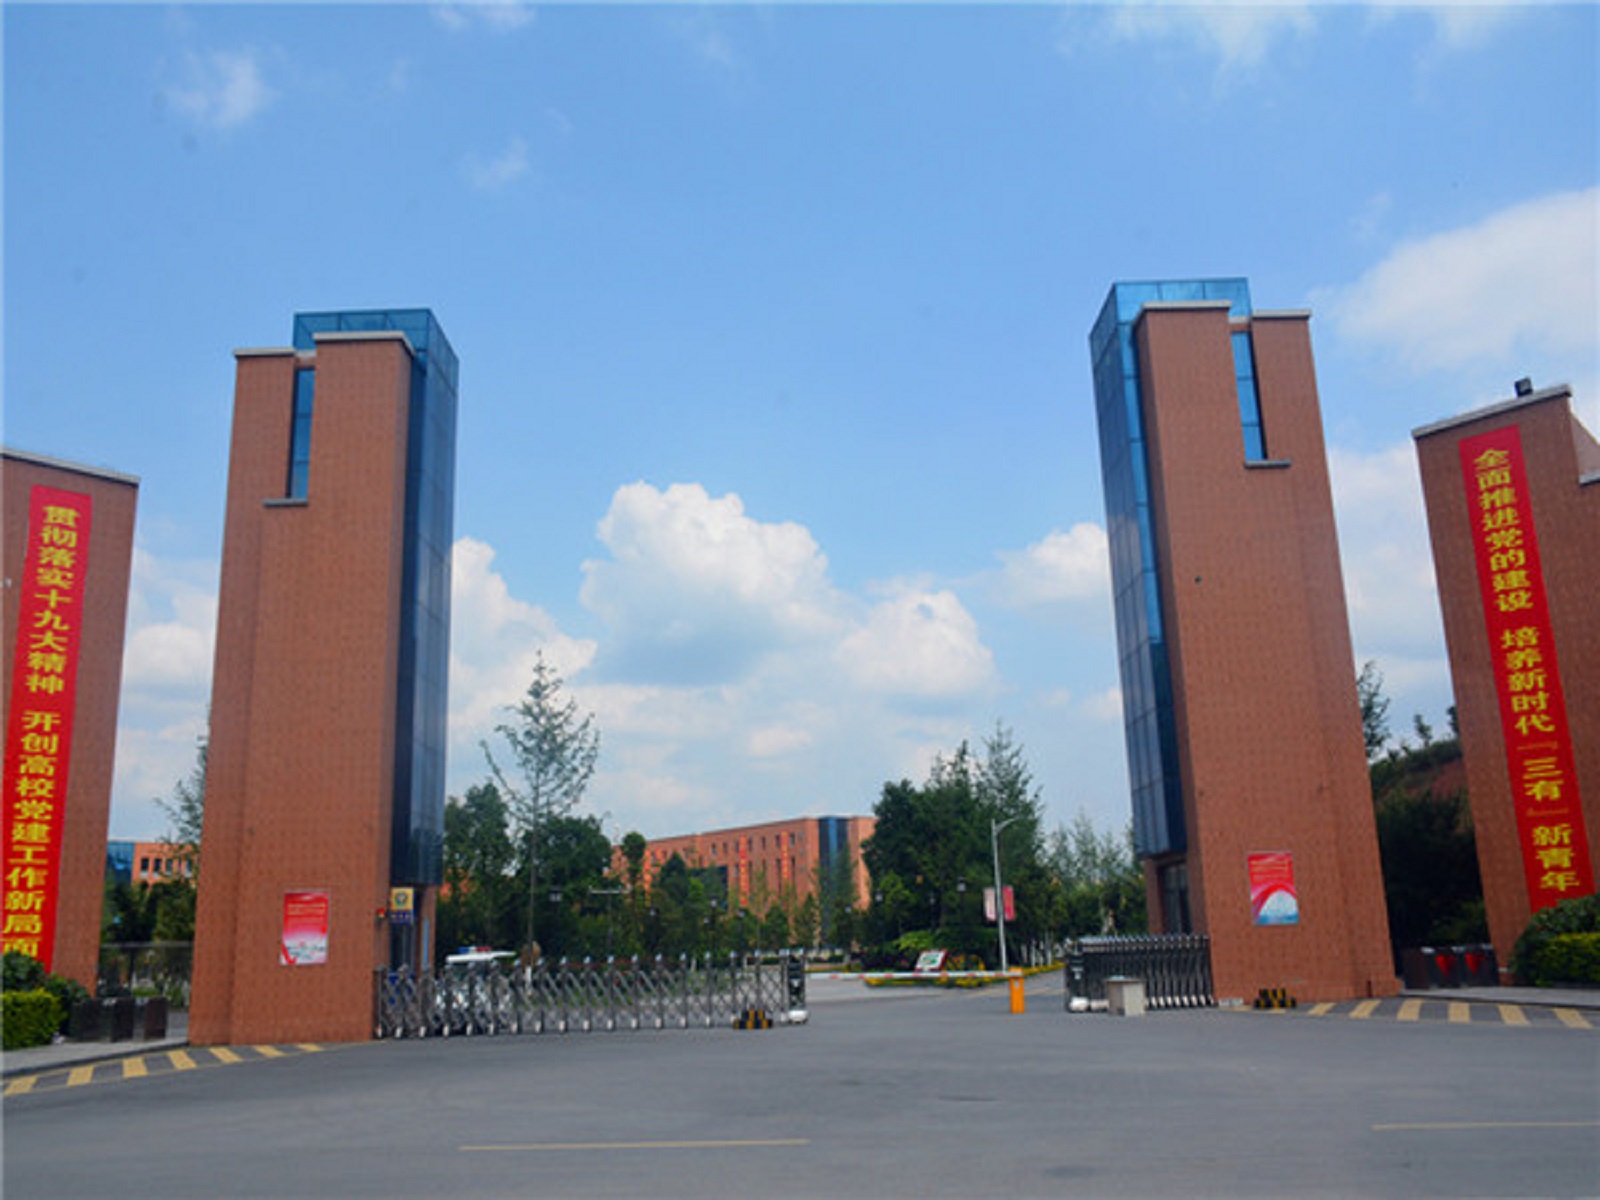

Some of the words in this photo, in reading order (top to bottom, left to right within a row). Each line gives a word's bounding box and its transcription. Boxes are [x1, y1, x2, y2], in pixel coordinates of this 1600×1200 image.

[25, 506, 80, 694] 贯彻落实十九大精神
[1474, 448, 1534, 612] 全面推进党的建设
[2, 710, 61, 957] 开创高校党建工作新局面
